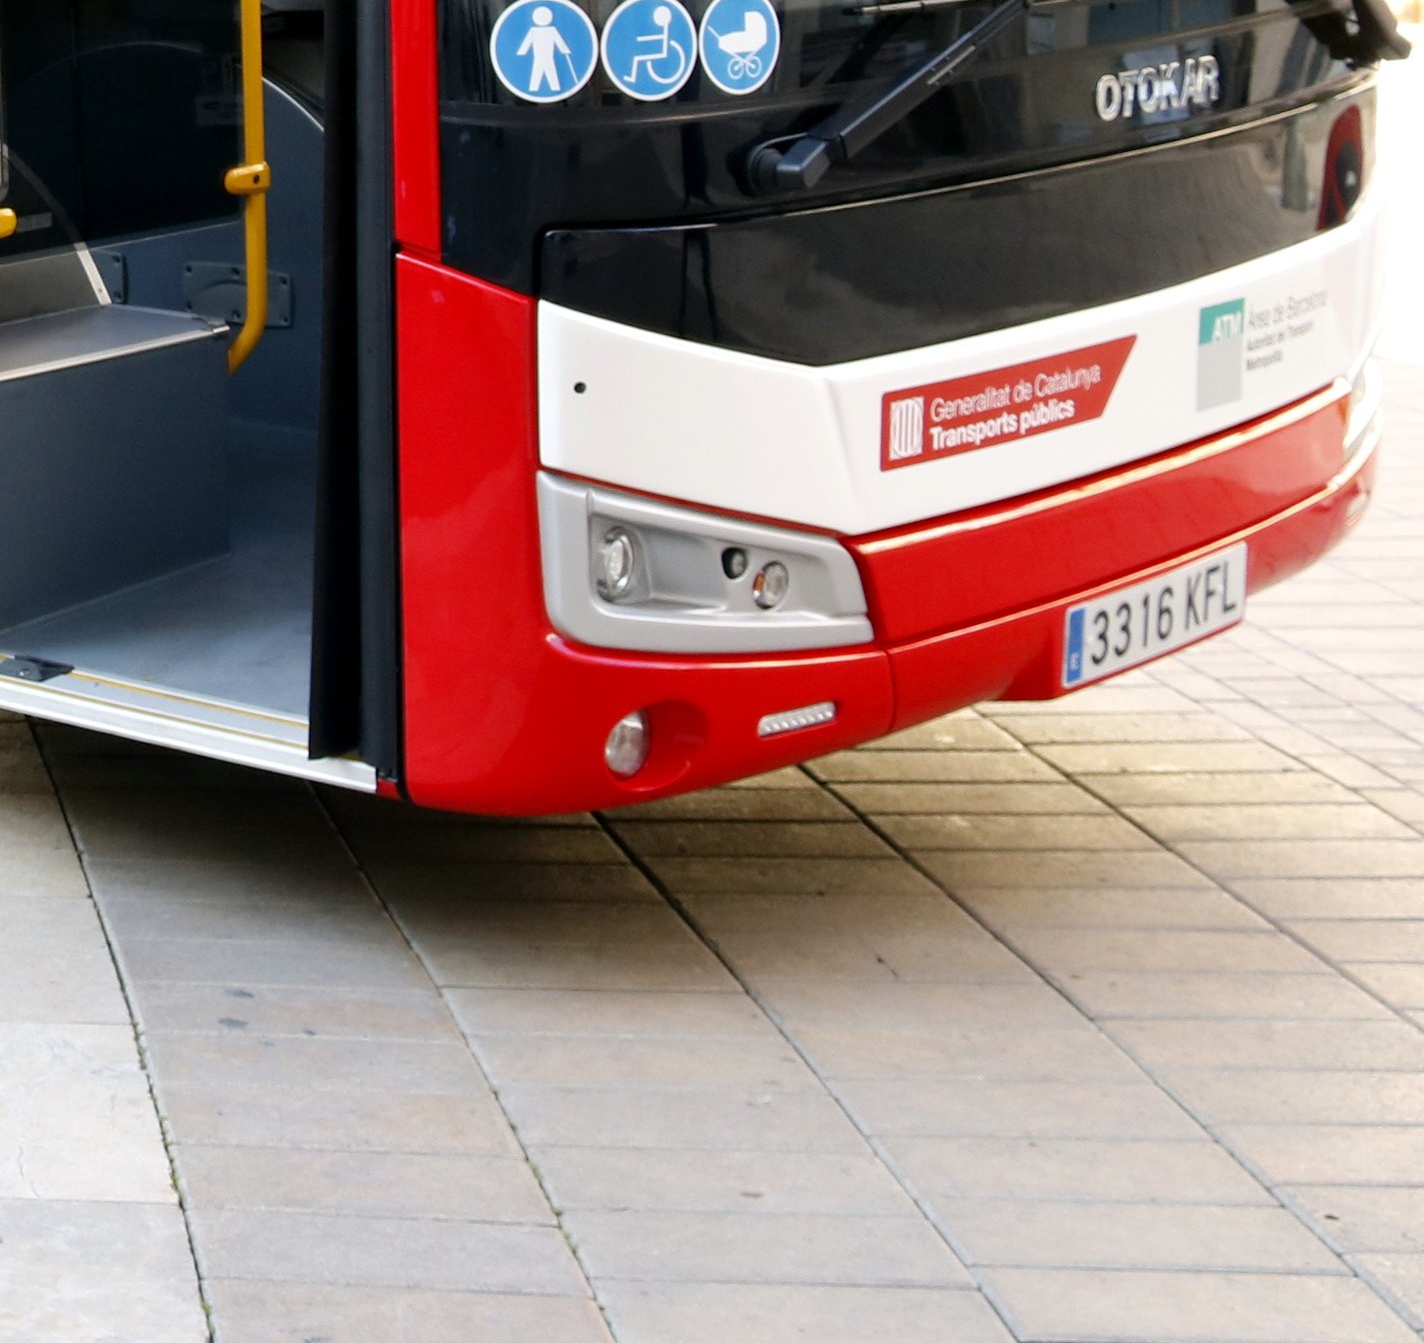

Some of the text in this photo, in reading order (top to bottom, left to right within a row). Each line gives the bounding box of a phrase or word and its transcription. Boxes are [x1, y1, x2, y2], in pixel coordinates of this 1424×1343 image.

[1096, 55, 1220, 122] OTOKAR
[1212, 310, 1243, 344] ATM
[930, 363, 1101, 422] Generalitat de Catalunya
[930, 398, 1075, 451] Transports públics
[1091, 585, 1174, 666] 3316
[1185, 560, 1238, 631] KFL
